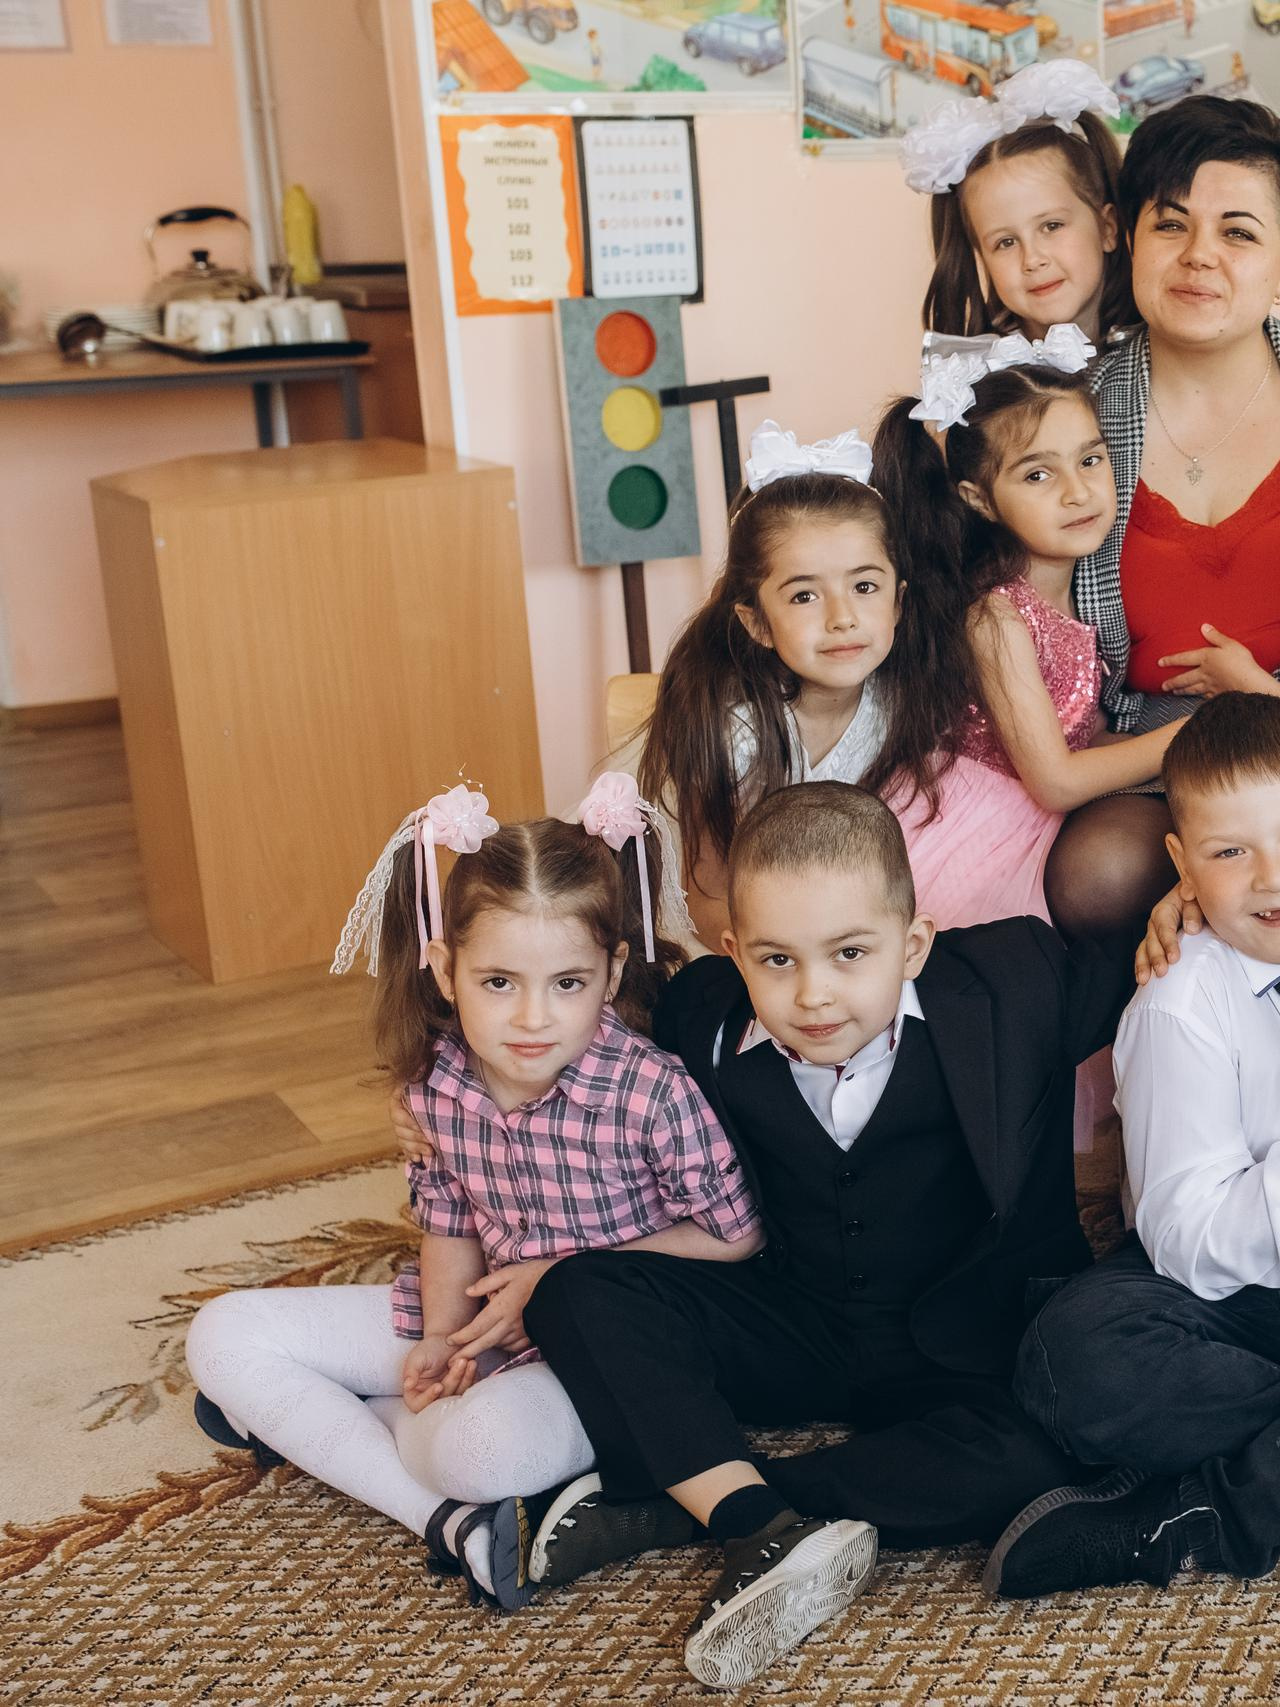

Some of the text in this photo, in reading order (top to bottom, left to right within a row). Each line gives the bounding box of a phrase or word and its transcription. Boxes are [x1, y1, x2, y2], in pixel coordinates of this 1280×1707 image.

[507, 197, 529, 210] 101
[508, 223, 531, 236] 102
[511, 274, 534, 287] 112
